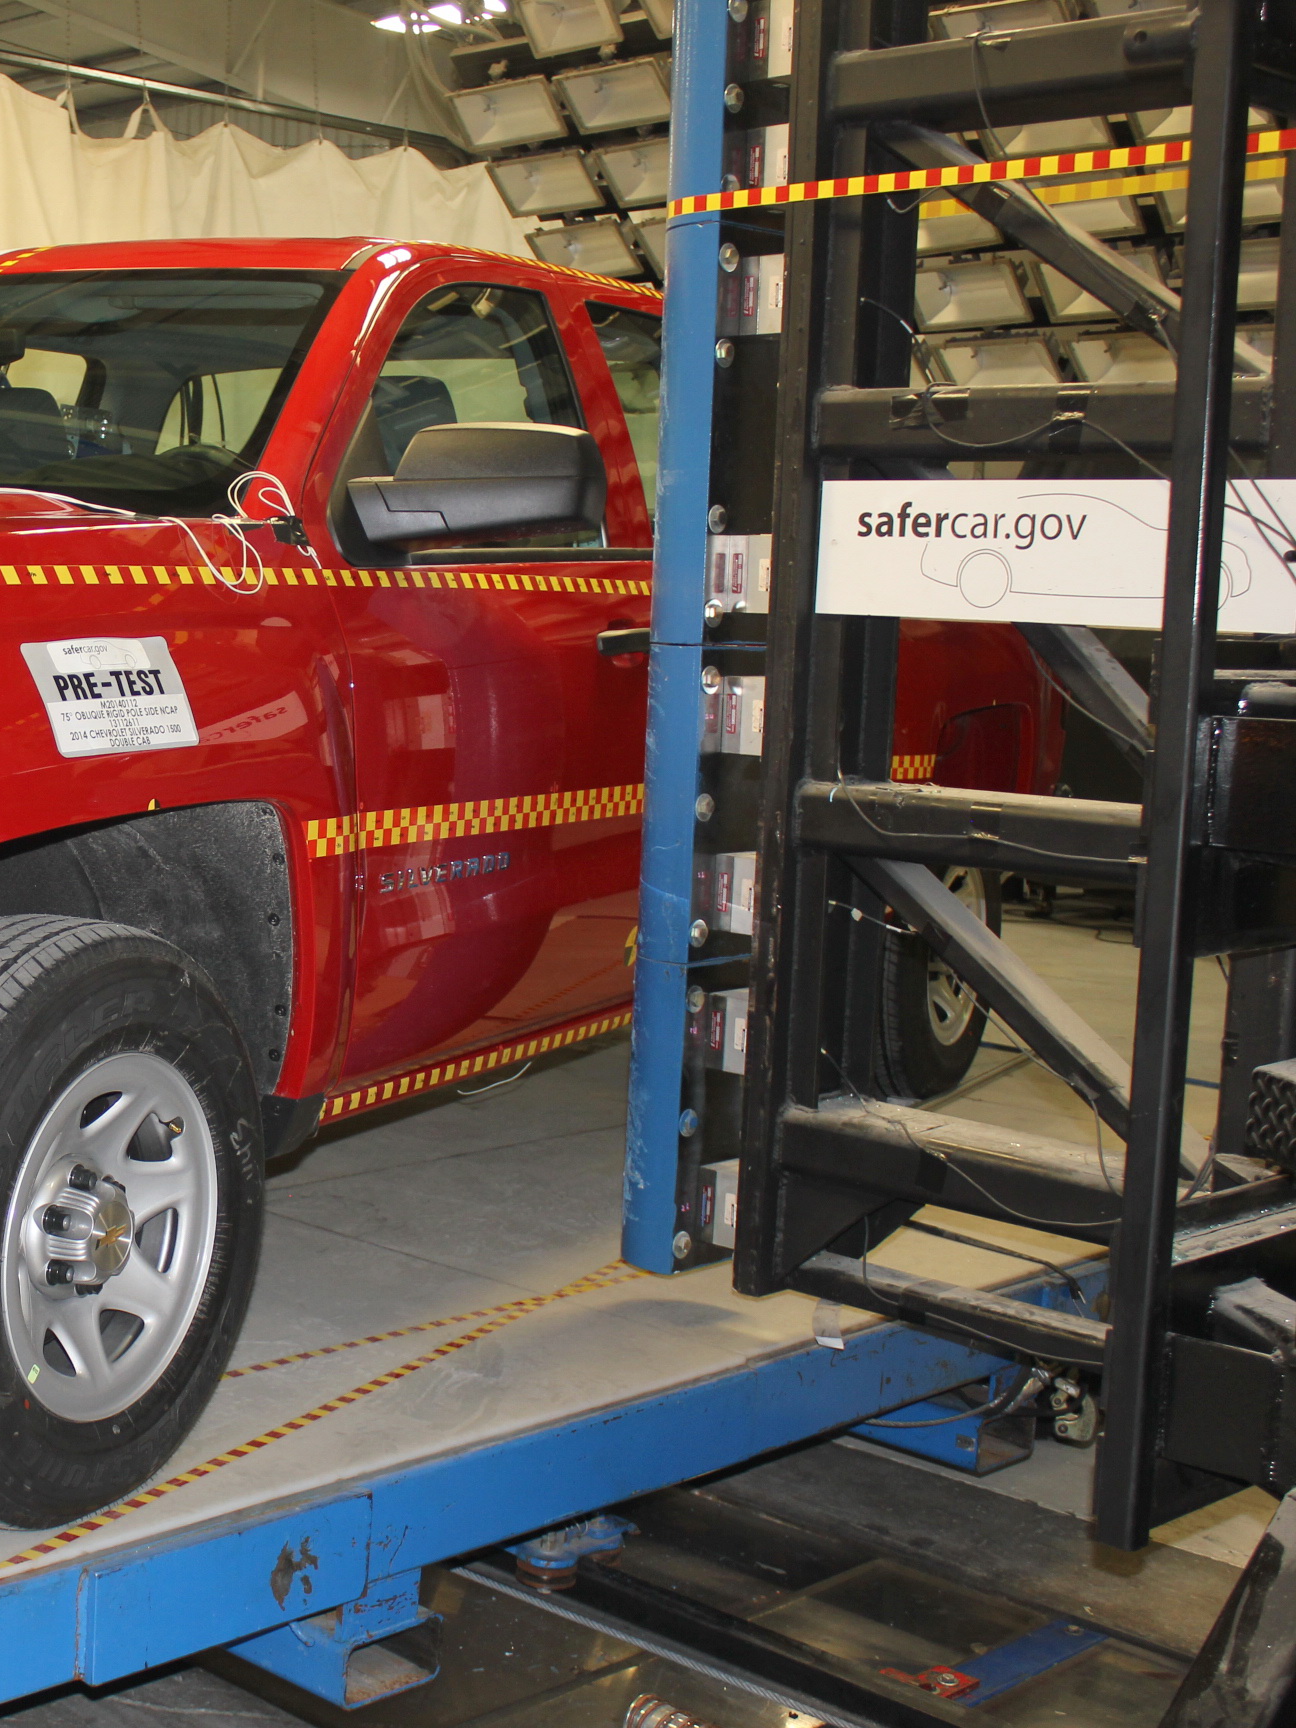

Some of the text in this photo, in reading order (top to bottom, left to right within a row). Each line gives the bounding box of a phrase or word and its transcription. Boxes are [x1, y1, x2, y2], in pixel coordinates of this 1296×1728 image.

[857, 501, 1088, 550] safercar.gov
[62, 641, 109, 655] safercar.gov
[52, 669, 166, 702] PRE-TEST
[100, 698, 139, 709] M20140112
[75, 710, 106, 722] OBLIQUE
[106, 709, 126, 719] RIGID
[126, 707, 144, 718] POLE
[145, 706, 159, 717] SIDE
[160, 705, 179, 716] NCAP
[109, 716, 141, 728] 13112611
[70, 724, 182, 742] 2014 CHEVROLET SILVERADO 1500
[109, 736, 152, 748] DOUBLE CAB
[379, 851, 511, 894] SILVERADO
